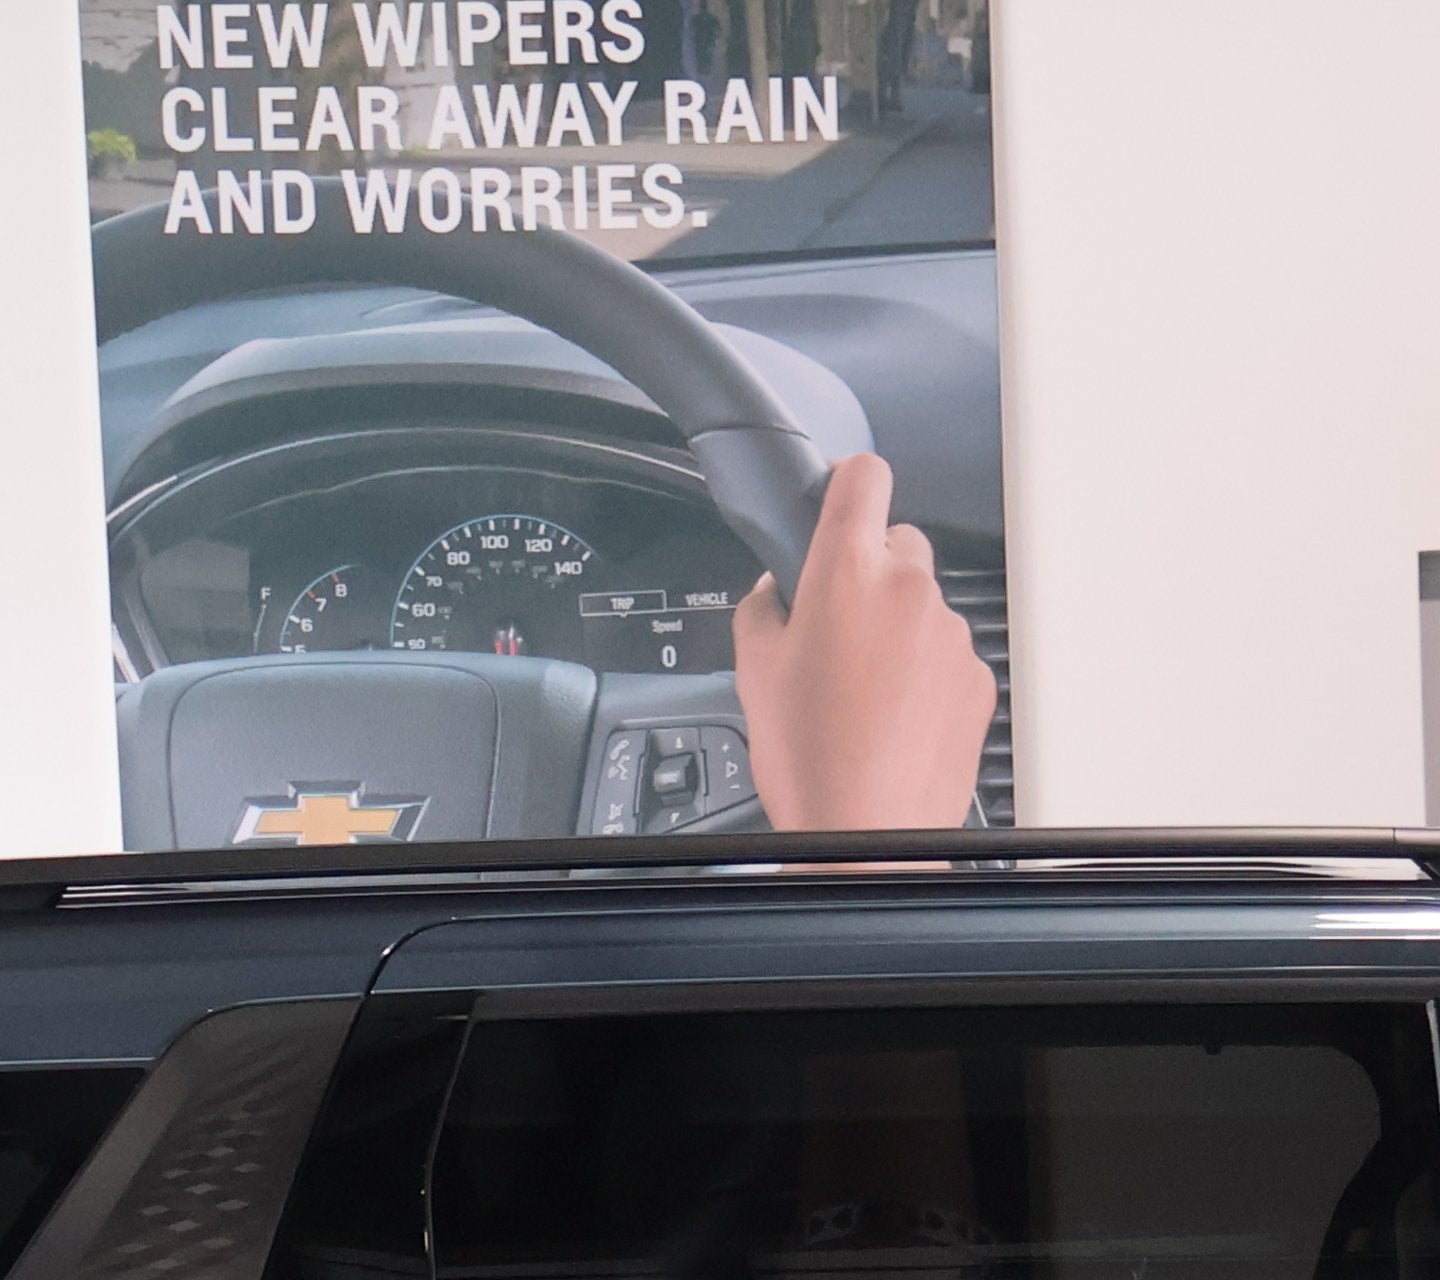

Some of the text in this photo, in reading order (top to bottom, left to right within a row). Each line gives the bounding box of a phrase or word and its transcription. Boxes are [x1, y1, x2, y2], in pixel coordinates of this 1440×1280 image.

[156, 0, 644, 70] NEW WIPERS
[162, 76, 839, 152] CLEAR AWAY RAIN
[164, 162, 709, 235] AND WORRIES.
[480, 535, 509, 549] 100
[524, 538, 553, 552] 120
[446, 551, 471, 566] 80
[554, 561, 582, 575] 140
[426, 575, 442, 587] 70
[261, 587, 271, 600] F
[334, 583, 348, 598] 8
[315, 598, 327, 612] 7
[610, 592, 729, 610] TRIP VEHICLE
[412, 603, 436, 617] 60
[300, 618, 313, 632] 6
[651, 618, 684, 634] Speed
[661, 645, 678, 668] 0
